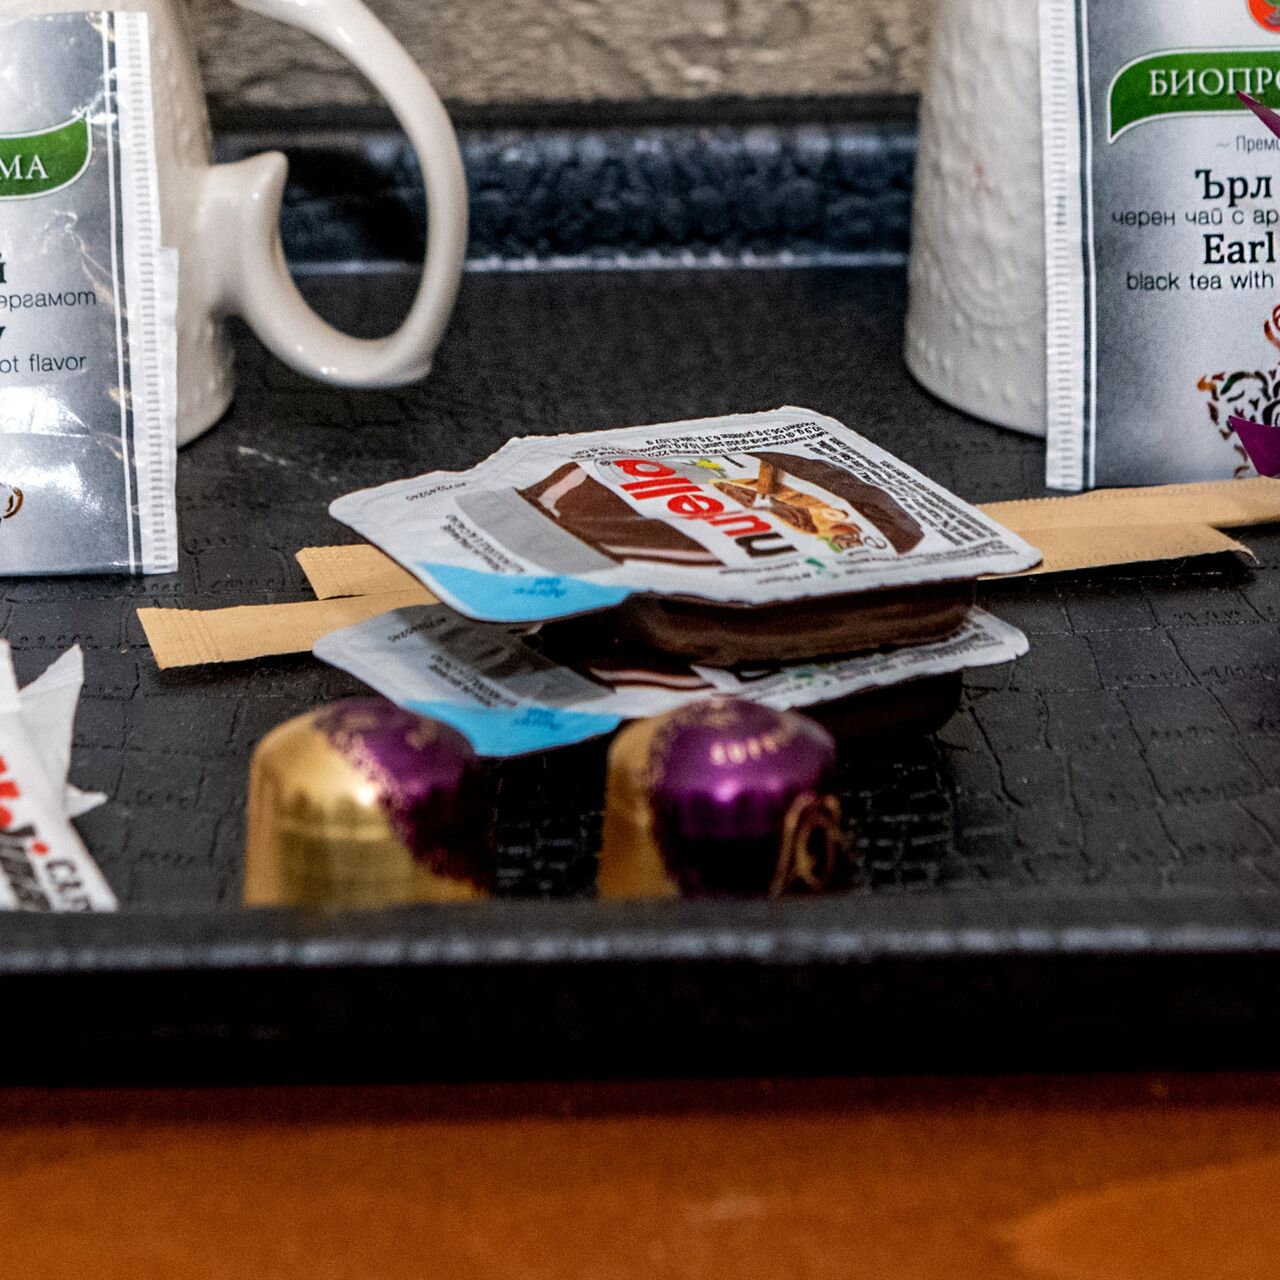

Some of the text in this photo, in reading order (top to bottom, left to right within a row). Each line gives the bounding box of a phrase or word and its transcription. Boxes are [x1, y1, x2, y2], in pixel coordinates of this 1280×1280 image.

[1195, 169, 1271, 206] Ърл
[1112, 209, 1176, 227] черен
[1185, 206, 1223, 227] чай
[1231, 210, 1245, 225] с
[1203, 232, 1276, 266] Earl
[1126, 270, 1179, 292] black
[1189, 273, 1222, 290] tea
[1230, 270, 1275, 289] with
[29, 352, 87, 376] flavor
[612, 458, 798, 558] nutella
